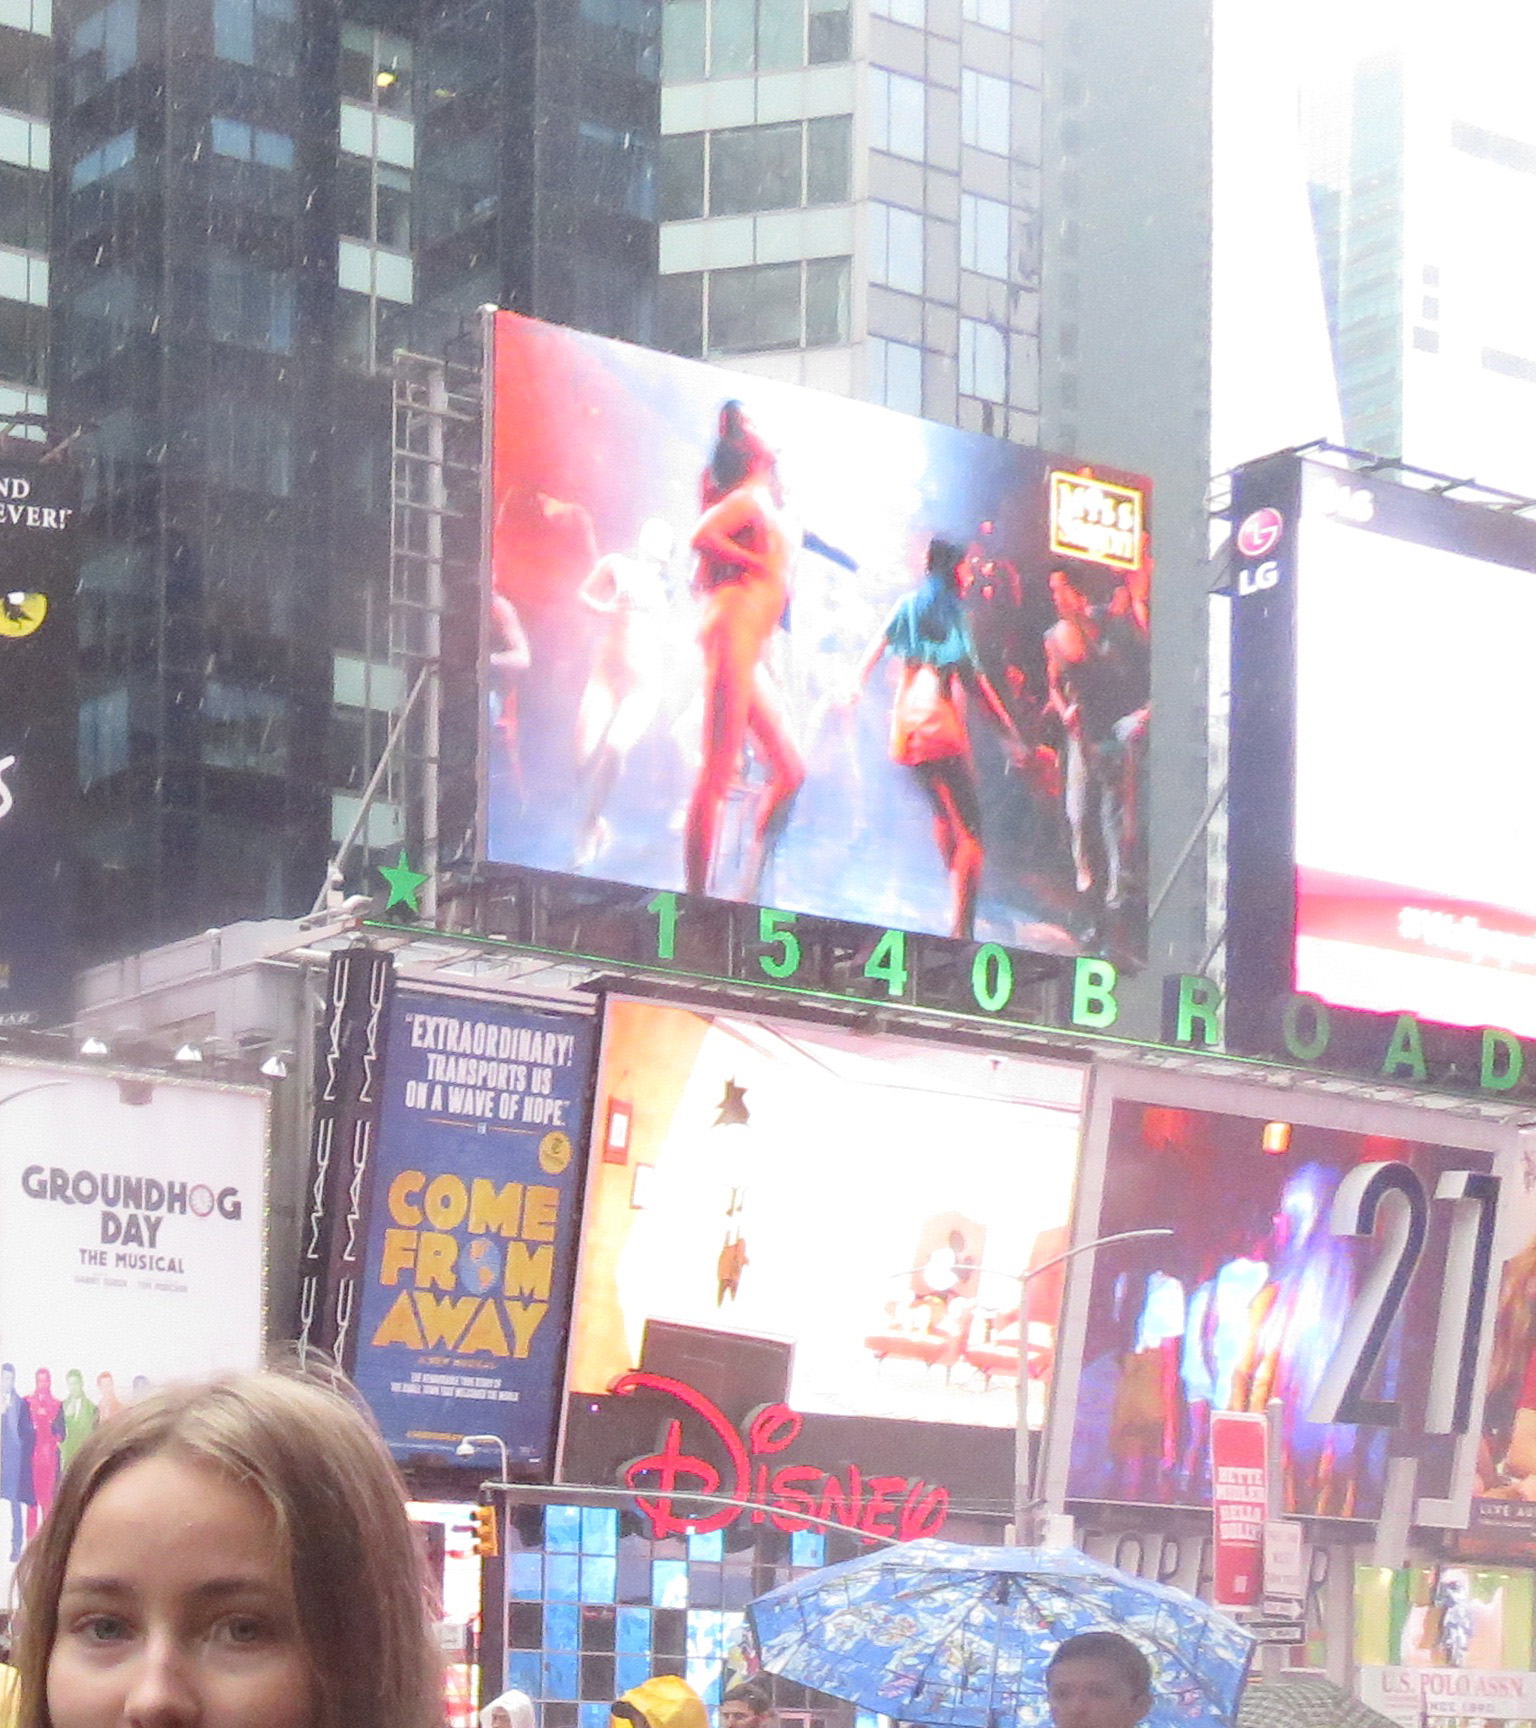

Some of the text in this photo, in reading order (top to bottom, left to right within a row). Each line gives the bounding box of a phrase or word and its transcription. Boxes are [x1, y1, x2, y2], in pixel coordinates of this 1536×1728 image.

[1238, 561, 1278, 596] LG
[427, 1053, 553, 1095] TRANSPORTS US
[405, 1080, 428, 1110] ON
[431, 1084, 443, 1111] A
[448, 1086, 495, 1118] WAVE
[499, 1092, 519, 1120] OF
[22, 1164, 242, 1220] GROUNDHOG
[388, 1170, 560, 1241] COME
[101, 1210, 163, 1248] DAY
[79, 1248, 185, 1274] THE MUSICAL
[371, 1289, 549, 1358] AWAY
[1421, 1674, 1470, 1696] POLO
